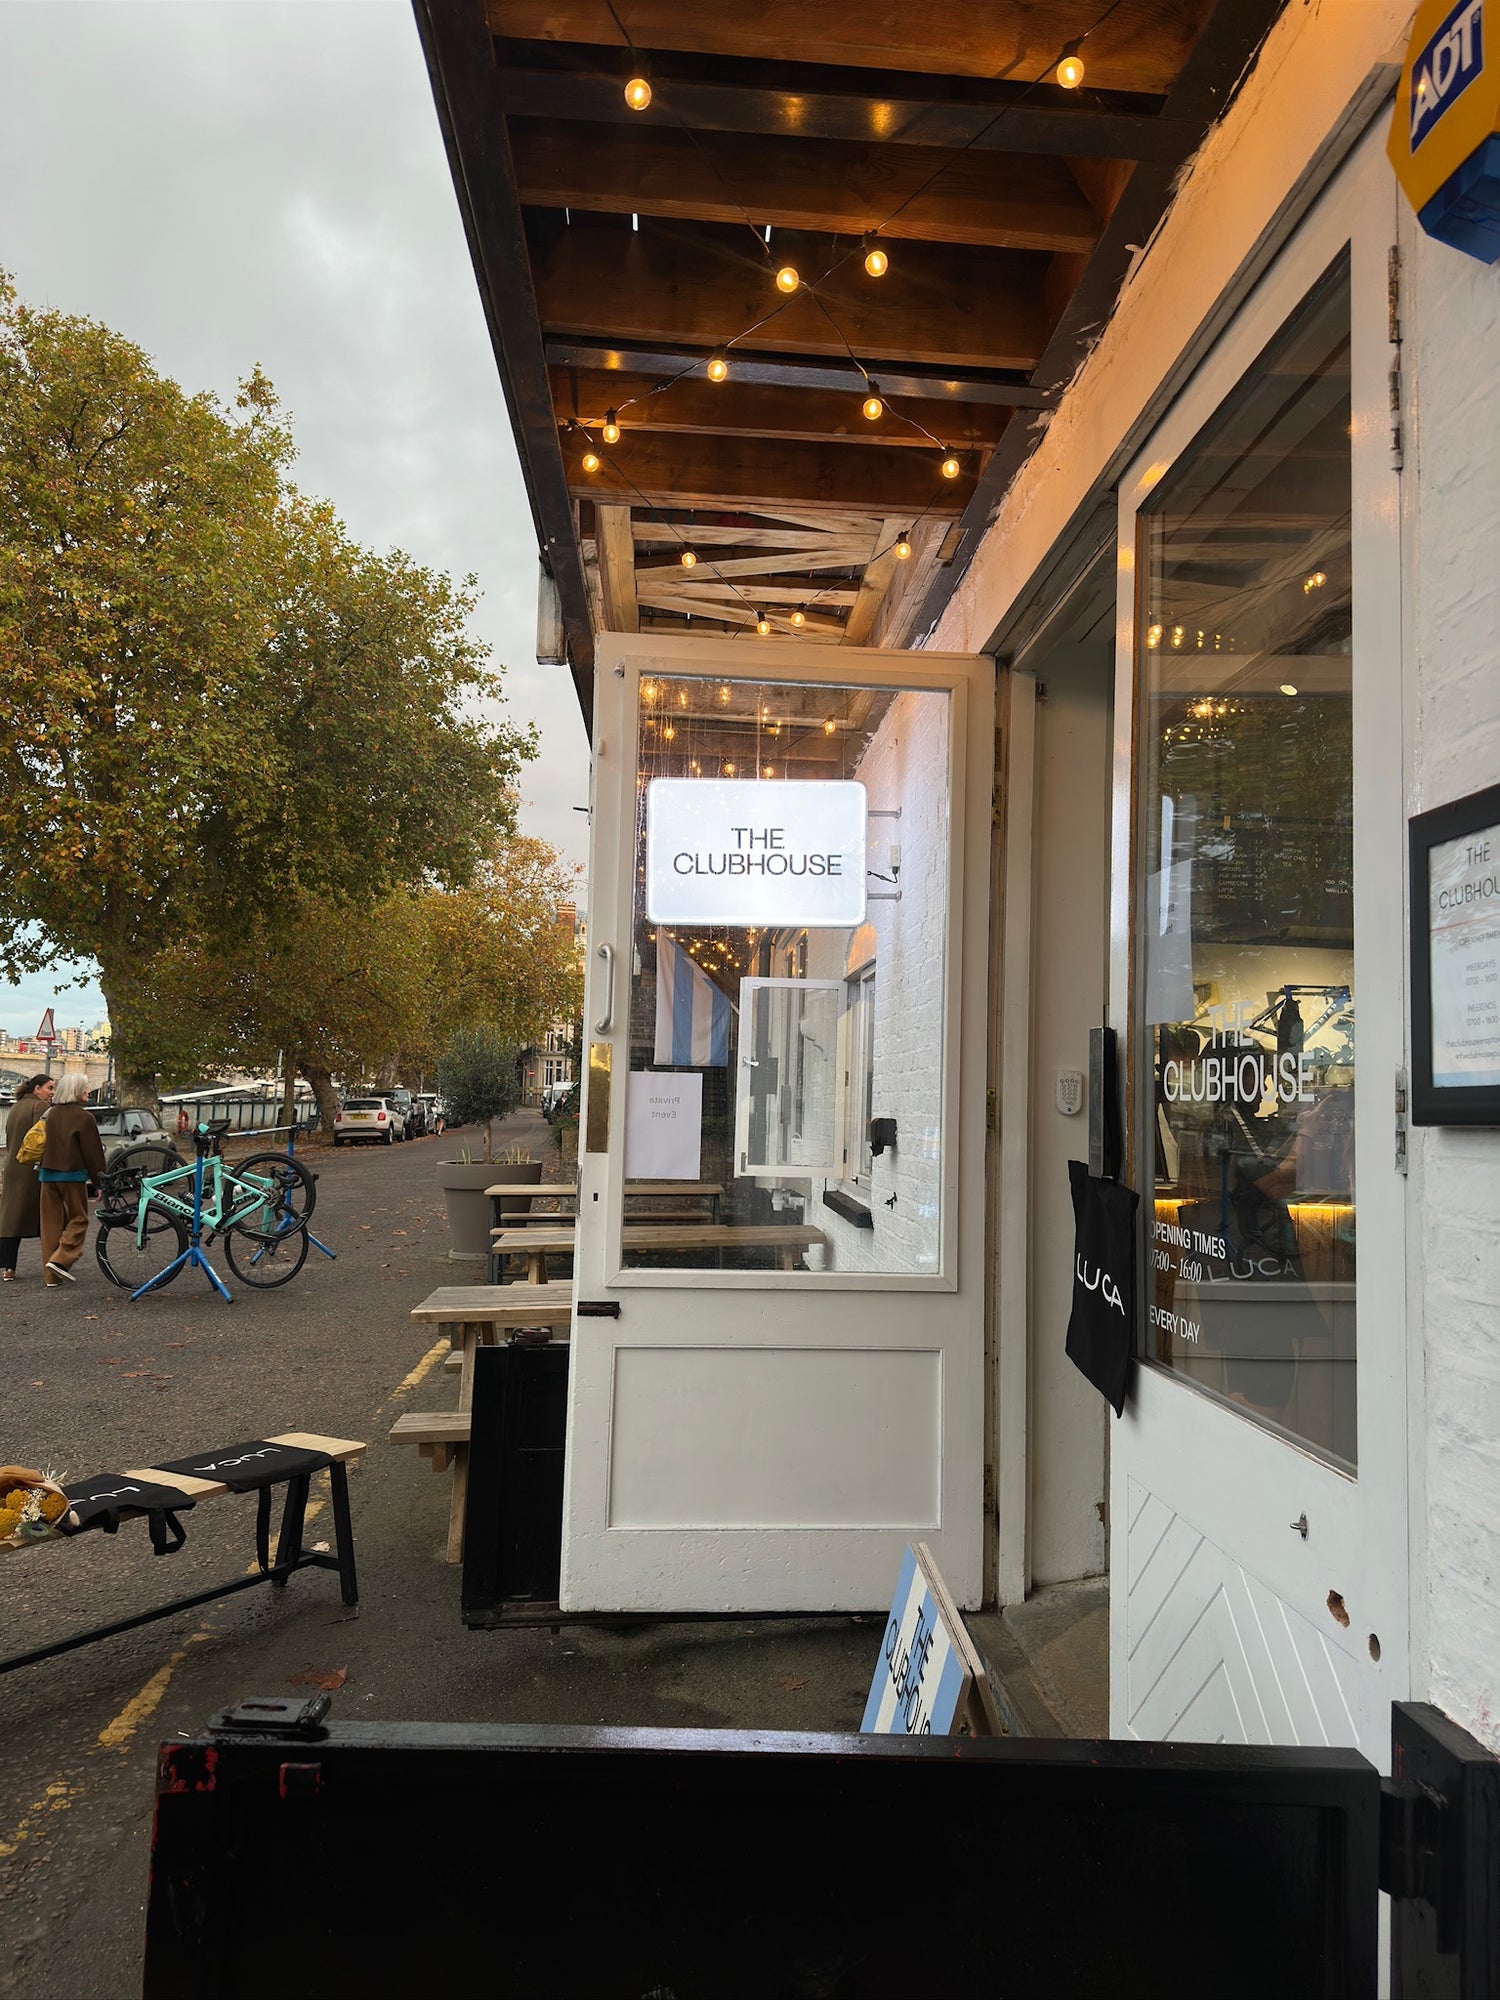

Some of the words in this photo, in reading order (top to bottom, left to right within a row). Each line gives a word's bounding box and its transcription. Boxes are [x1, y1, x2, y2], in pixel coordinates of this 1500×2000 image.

[1410, 0, 1481, 140] ADT
[731, 828, 785, 849] THE
[673, 852, 842, 875] CLUBHOUSE
[1466, 842, 1490, 866] THE
[1465, 960, 1496, 973] WEEKDAYS
[1467, 1001, 1496, 1013] WEEKENDS
[1208, 1001, 1254, 1049] THE
[1163, 1052, 1315, 1103] CLUBHOUSE
[1193, 1231, 1226, 1260] TIMES
[1179, 1257, 1201, 1283] 16:00
[1207, 1257, 1298, 1284] LUCA
[1077, 1252, 1126, 1317] LUCA
[1150, 1304, 1179, 1334] EVERY
[1180, 1317, 1200, 1343] DAY
[193, 1448, 281, 1471] LUCA
[909, 1604, 934, 1684] THE
